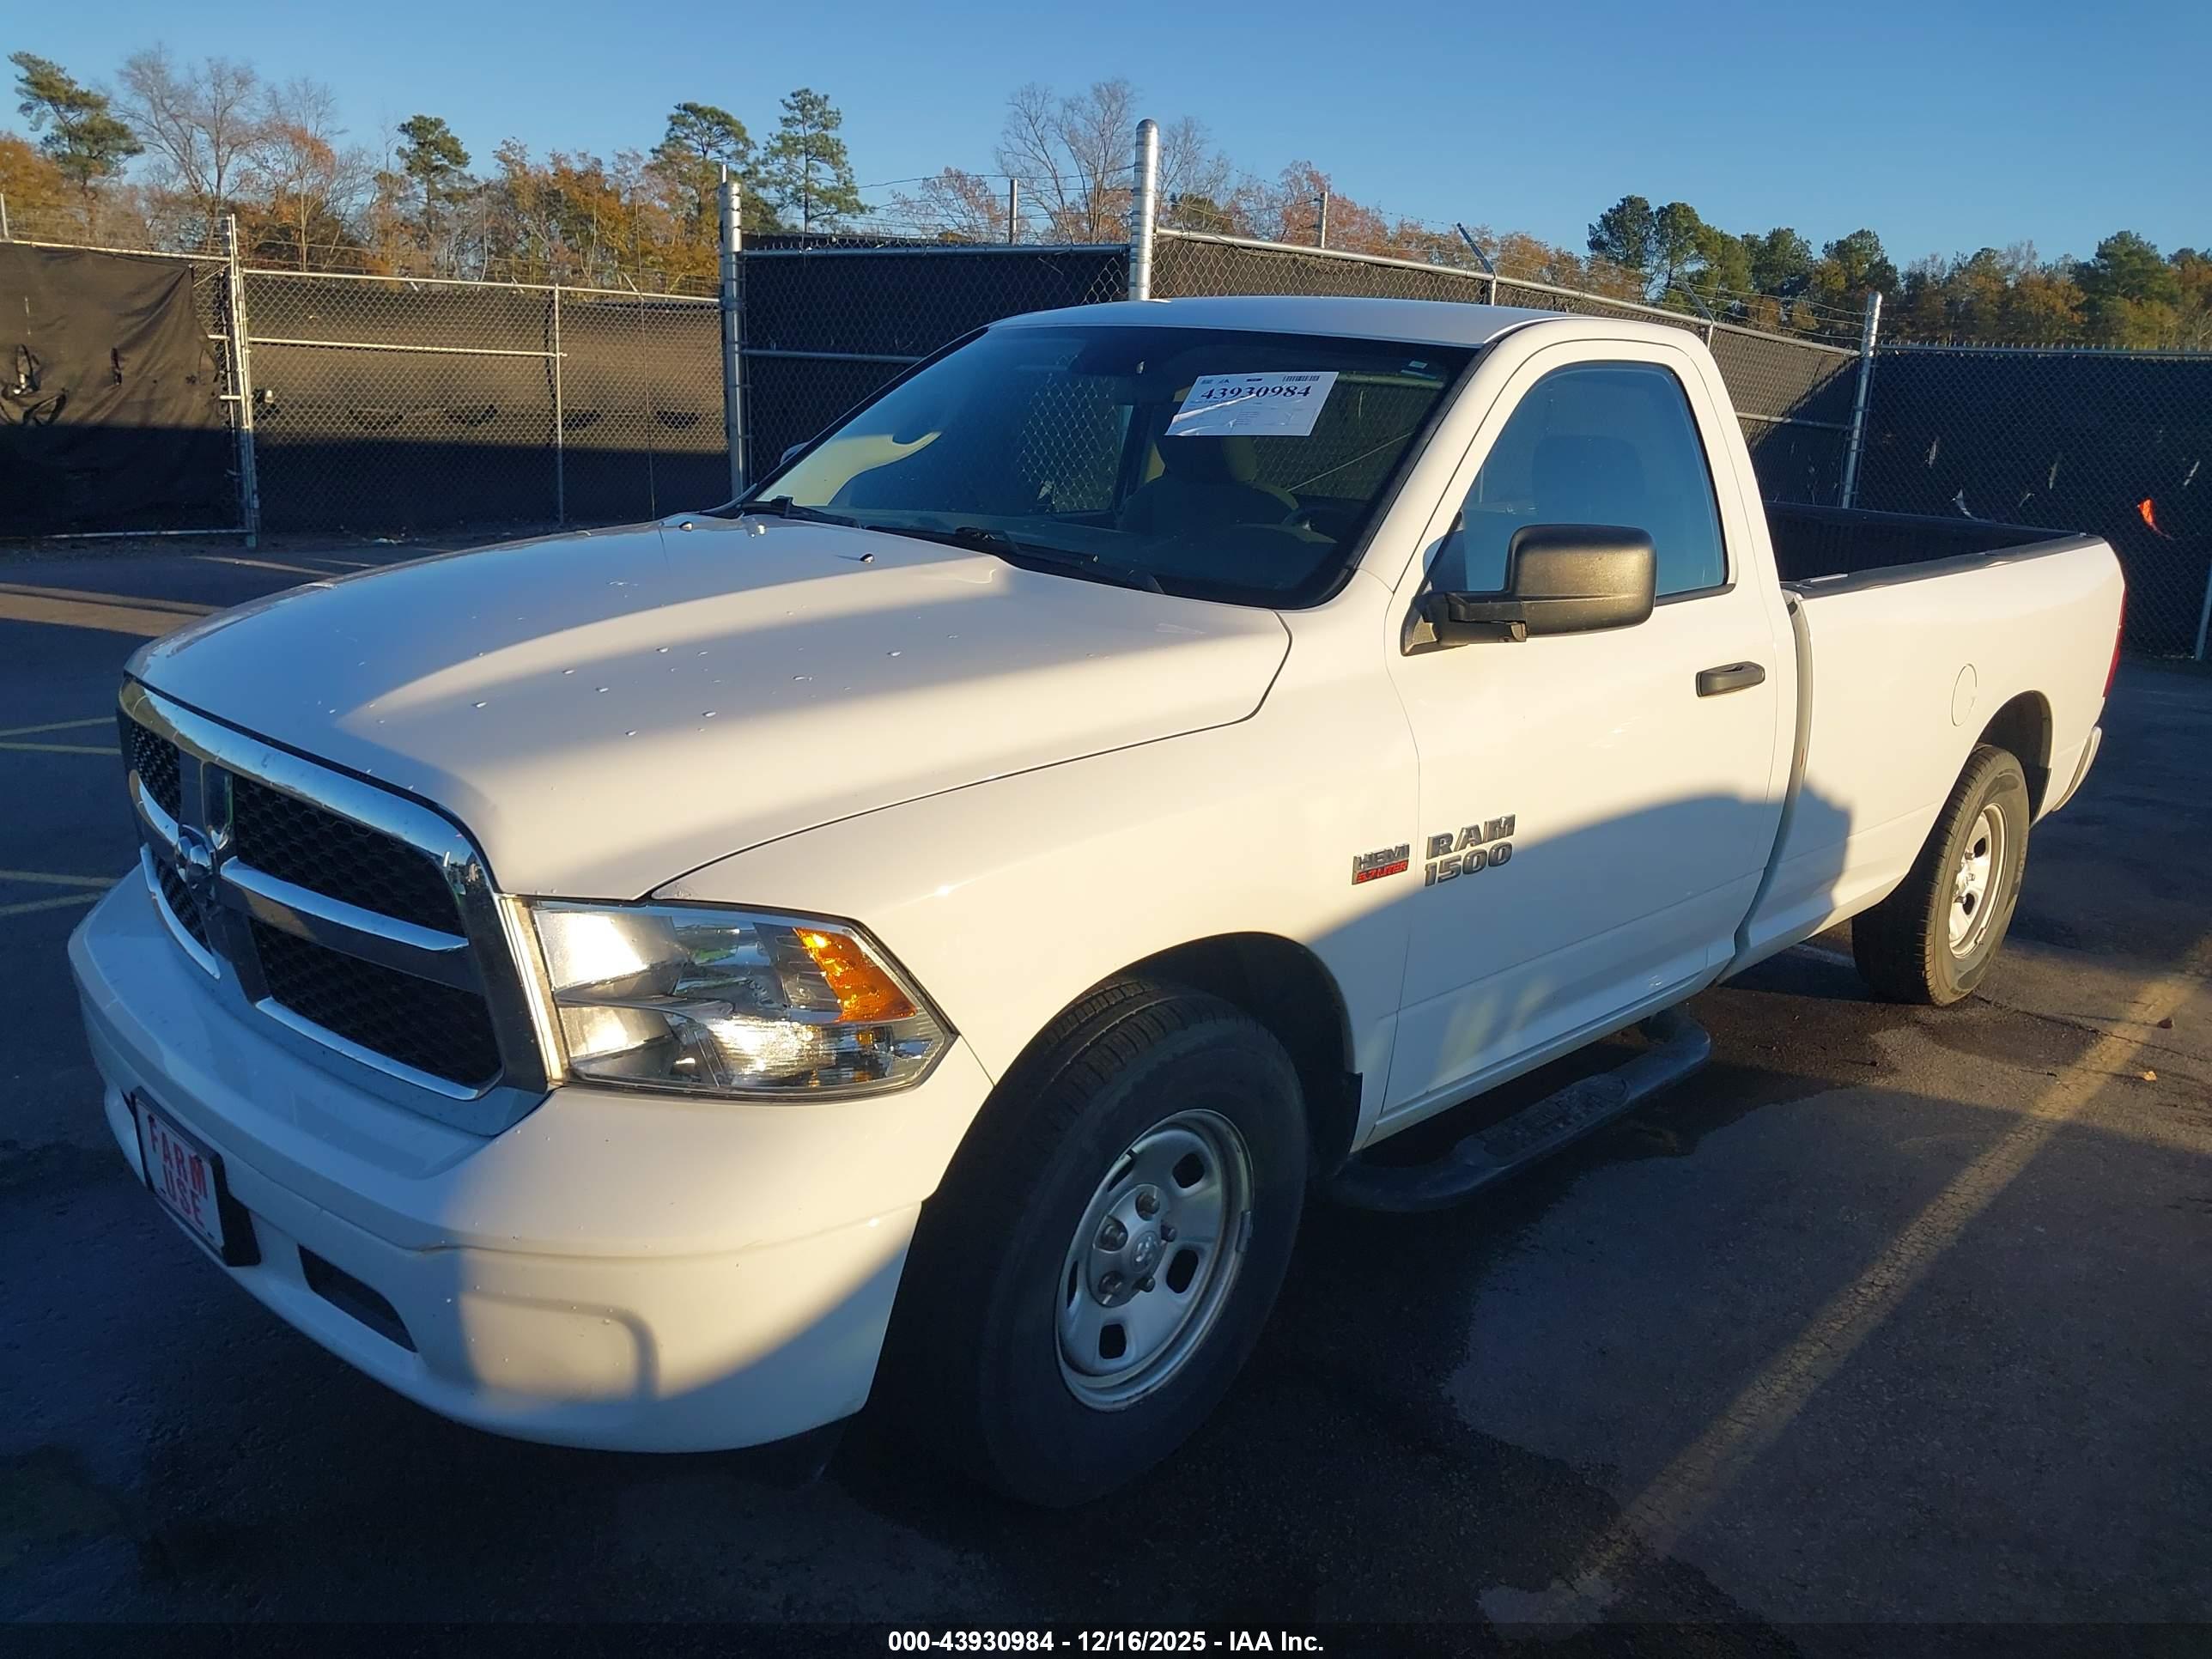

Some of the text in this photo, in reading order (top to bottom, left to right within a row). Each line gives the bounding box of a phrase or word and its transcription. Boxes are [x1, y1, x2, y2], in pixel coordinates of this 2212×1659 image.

[1200, 385, 1311, 400] 43930984
[1353, 843, 1410, 872] HEMI
[1426, 813, 1516, 860] RAM
[1425, 842, 1513, 887] 1500
[147, 1114, 208, 1200] FARM
[164, 1166, 205, 1229] USE
